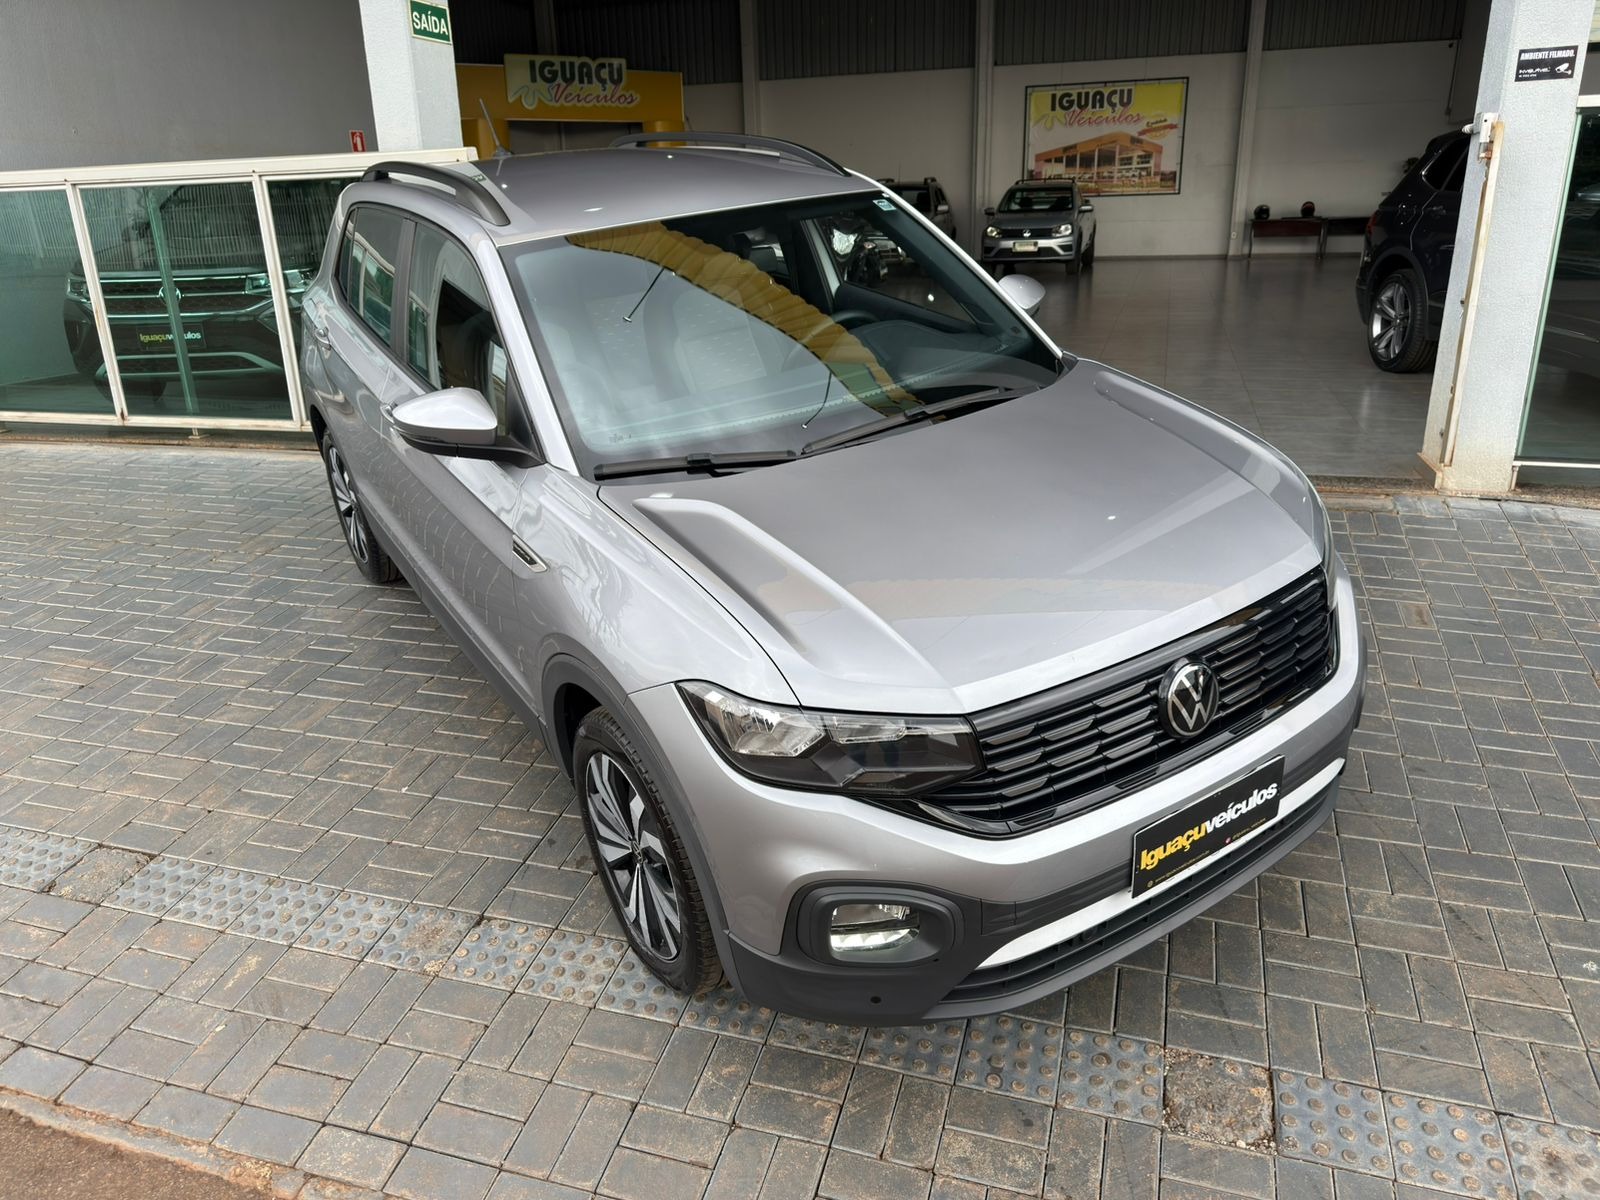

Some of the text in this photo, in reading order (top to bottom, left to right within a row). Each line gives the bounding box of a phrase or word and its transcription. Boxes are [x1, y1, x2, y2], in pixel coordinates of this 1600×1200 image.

[412, 10, 449, 36] SAÍDA
[1520, 51, 1549, 60] AMBIENTE
[529, 59, 623, 92] IGUAÇU
[551, 82, 638, 105] Veículos
[1050, 88, 1133, 114] IGUAÇU
[1065, 105, 1145, 128] Veículos
[139, 331, 202, 343] Iguaçuvulos
